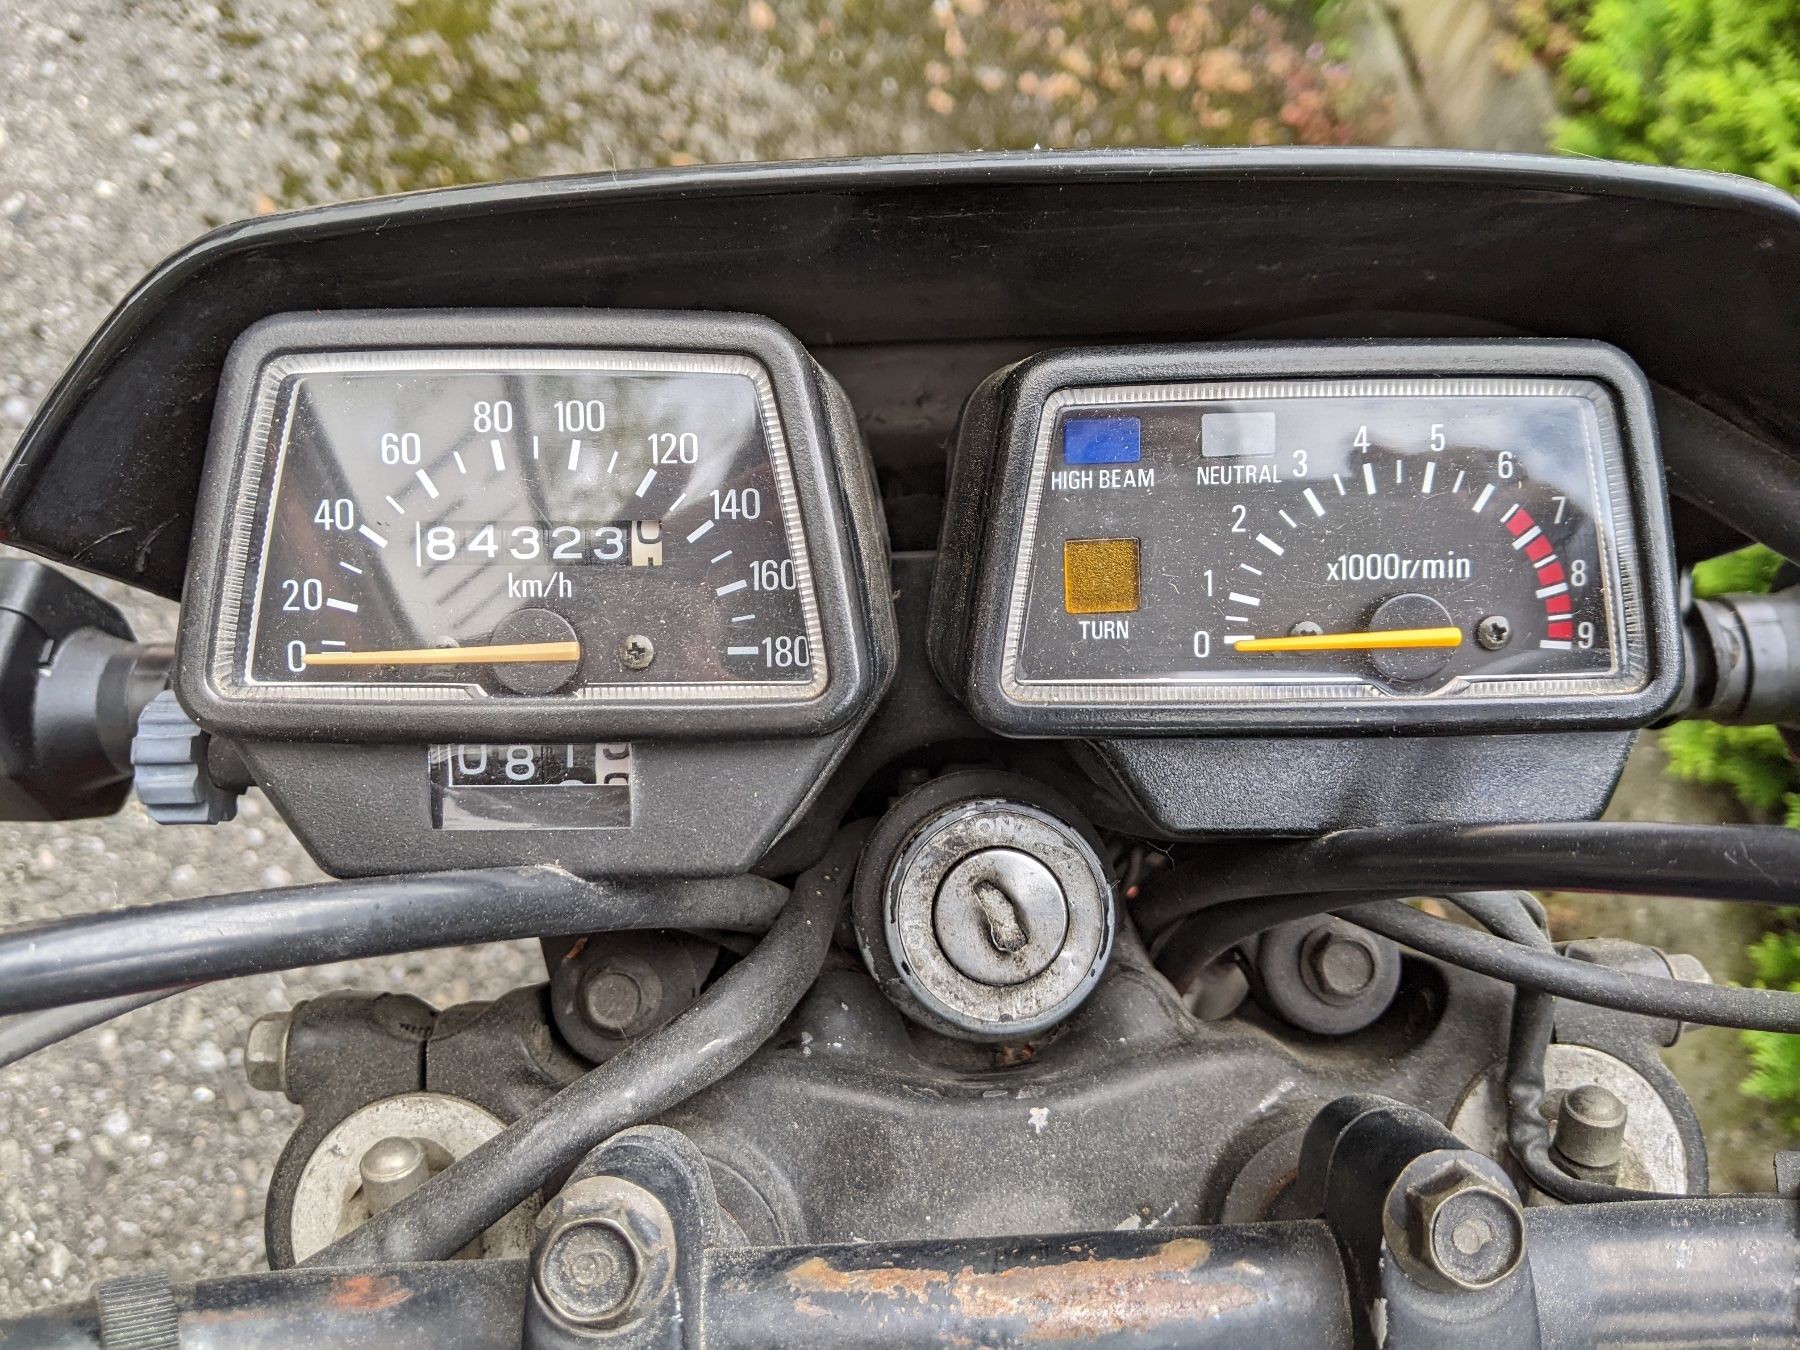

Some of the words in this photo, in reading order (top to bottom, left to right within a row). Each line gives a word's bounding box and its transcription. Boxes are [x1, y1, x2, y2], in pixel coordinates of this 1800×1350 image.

[473, 401, 513, 432] 80
[554, 400, 605, 432] 100
[381, 433, 421, 464] 60
[648, 433, 699, 464] 120
[1353, 426, 1371, 453] 4
[1430, 424, 1446, 452] 5
[1197, 464, 1282, 485] NEUTRAL
[1292, 450, 1308, 477] 3
[1498, 451, 1513, 479] 6
[1051, 470, 1093, 490] HIGH
[1100, 468, 1154, 489] BEAM
[313, 498, 354, 530] 40
[709, 488, 760, 520] 140
[1551, 497, 1566, 525] 7
[1232, 505, 1246, 532] 2
[508, 572, 572, 598] km/h
[749, 559, 797, 590] 160
[1204, 570, 1213, 596] 1
[1571, 560, 1587, 587] 8
[282, 579, 322, 611] 20
[1079, 620, 1129, 639] TURN
[1578, 622, 1594, 649] 9
[287, 640, 306, 672] 0
[761, 636, 810, 667] 180
[1193, 631, 1209, 658] 0
